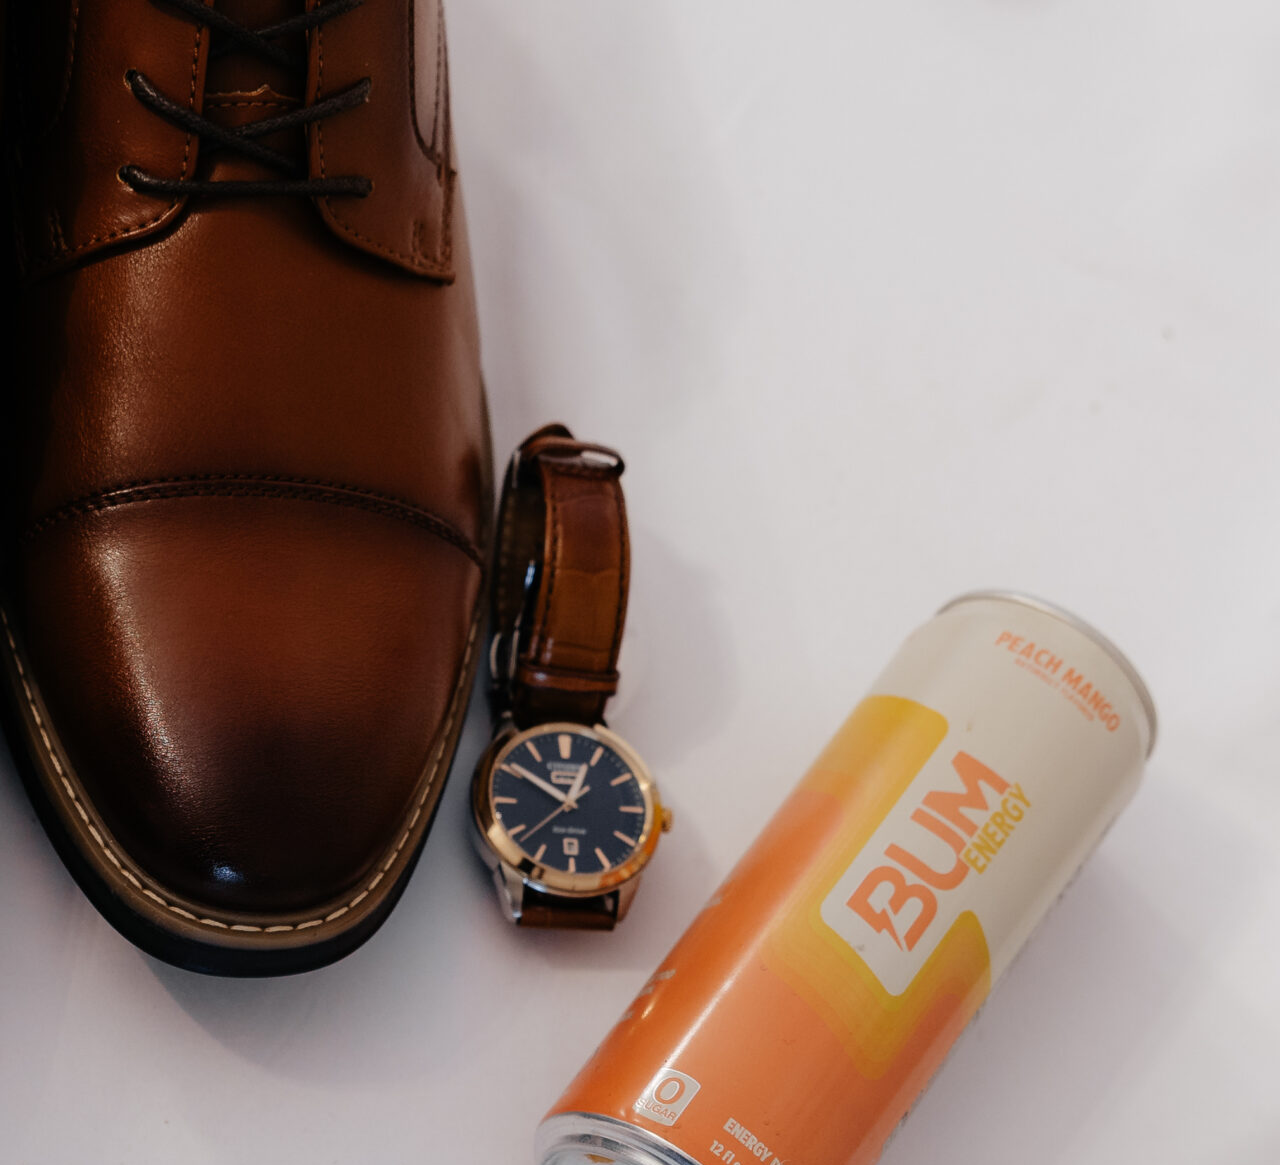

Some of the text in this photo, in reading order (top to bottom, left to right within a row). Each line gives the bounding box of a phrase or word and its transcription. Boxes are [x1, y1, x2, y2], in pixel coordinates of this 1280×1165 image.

[995, 630, 1064, 676] PEACH
[1061, 668, 1120, 733] MANGO
[845, 750, 1010, 952] BUM
[961, 782, 1031, 875] ENERGY
[636, 1098, 677, 1121] SUGAR
[723, 1117, 773, 1162] ENERGY
[710, 1140, 725, 1156] 12
[722, 1150, 736, 1165] fl
